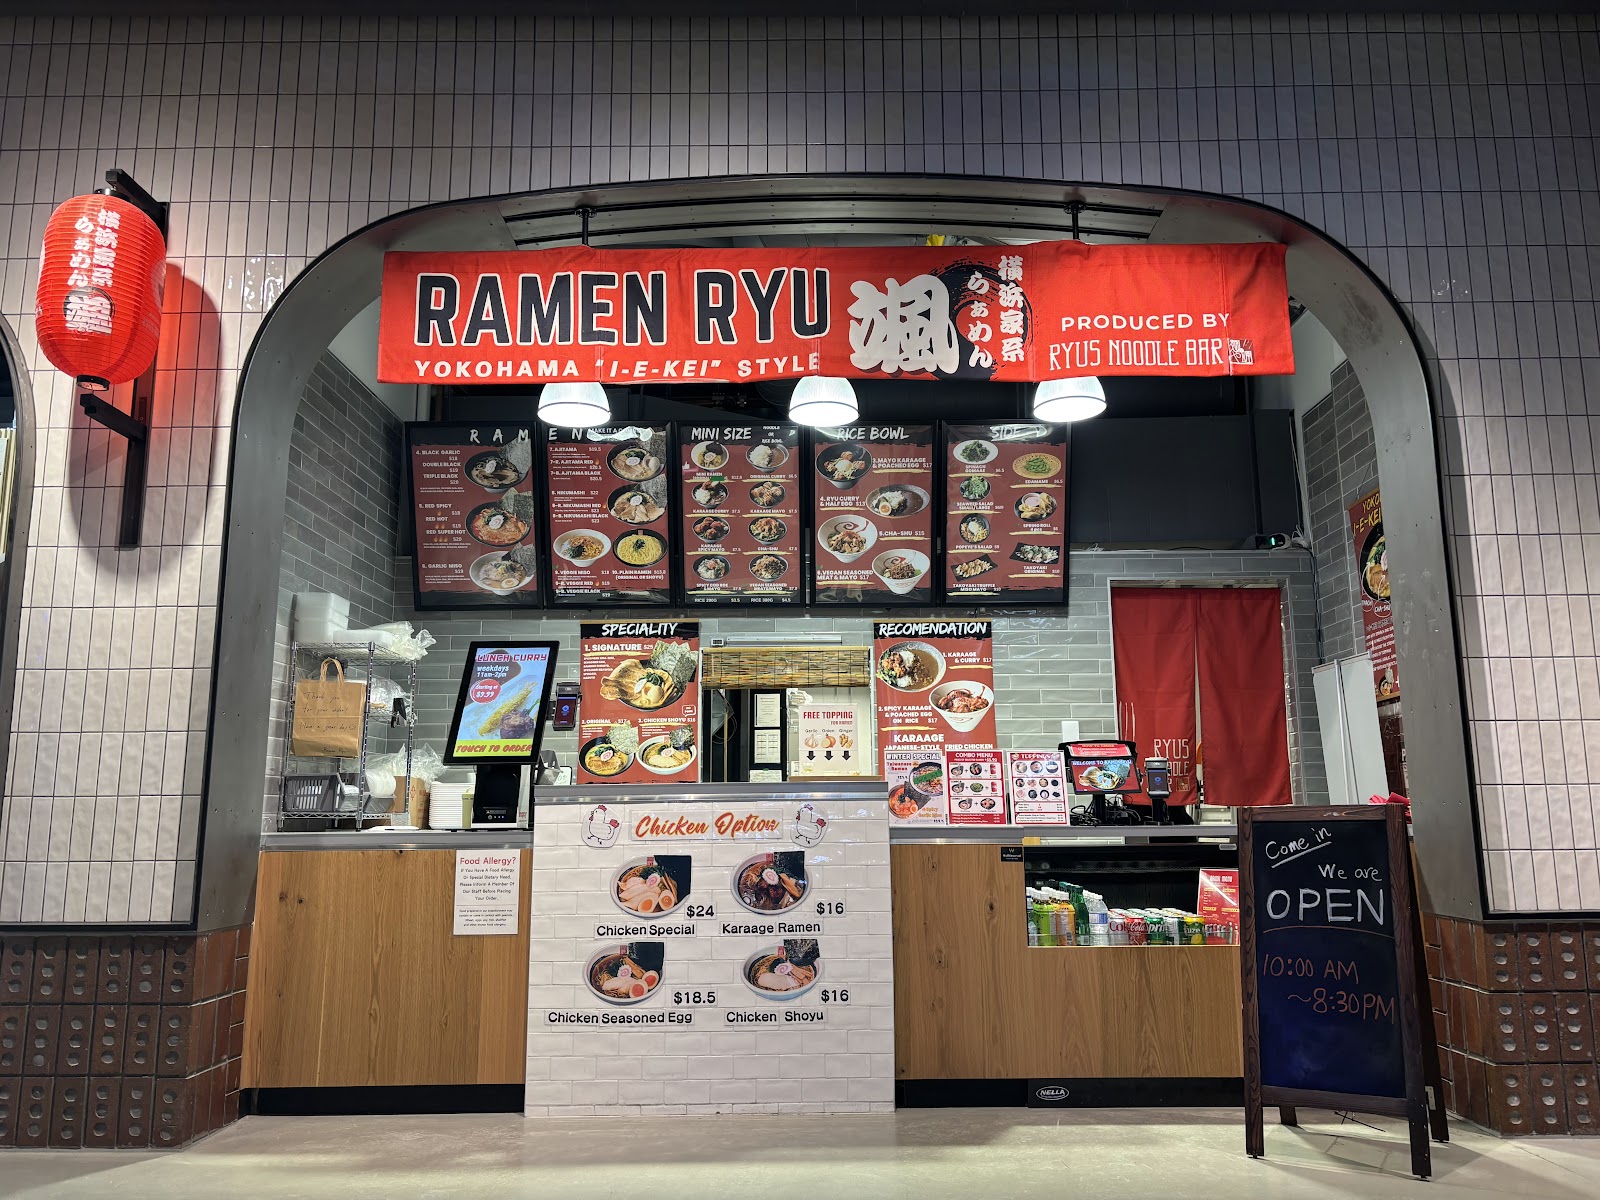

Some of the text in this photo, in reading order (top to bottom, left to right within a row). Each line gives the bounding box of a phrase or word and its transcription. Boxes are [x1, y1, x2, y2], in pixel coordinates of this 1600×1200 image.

[413, 267, 830, 346] RAMEN RYU
[998, 254, 1025, 362] 横浜家系
[968, 271, 994, 368] らぁめん
[1061, 313, 1230, 332] PRODUCED BY
[1048, 339, 1101, 371] RYUS
[1109, 339, 1178, 367] NOODLE
[1185, 339, 1224, 366] BAR
[415, 360, 579, 378] YOKOHAMA
[737, 353, 821, 378] STYLE
[692, 427, 751, 440] MINI SIZE
[837, 427, 909, 440] RICE BOWL
[1362, 493, 1379, 513] YOKO
[601, 623, 678, 636] SPECIALITY
[879, 623, 987, 636] RECOMENDATION
[476, 654, 547, 662] LUNCH CURRY
[804, 711, 820, 719] FREE
[894, 734, 944, 742] KARAAGE
[1154, 739, 1189, 758] RYUS
[635, 812, 780, 838] Chicken Option
[1266, 828, 1331, 860] Come in
[483, 857, 516, 865] Allergy?
[1318, 863, 1382, 881] We are
[686, 905, 715, 917] $24
[816, 902, 844, 914] $16
[1267, 888, 1384, 925] OPEN
[596, 924, 695, 936] Chicken Special
[722, 922, 820, 936] Karaage Ramen
[1263, 954, 1359, 984] 10:00 AM
[673, 991, 716, 1004] $18.5
[821, 989, 849, 1002] $16
[548, 1012, 692, 1024] Chicken Seasoned Egg
[726, 1010, 823, 1023] Chicken Shoyu
